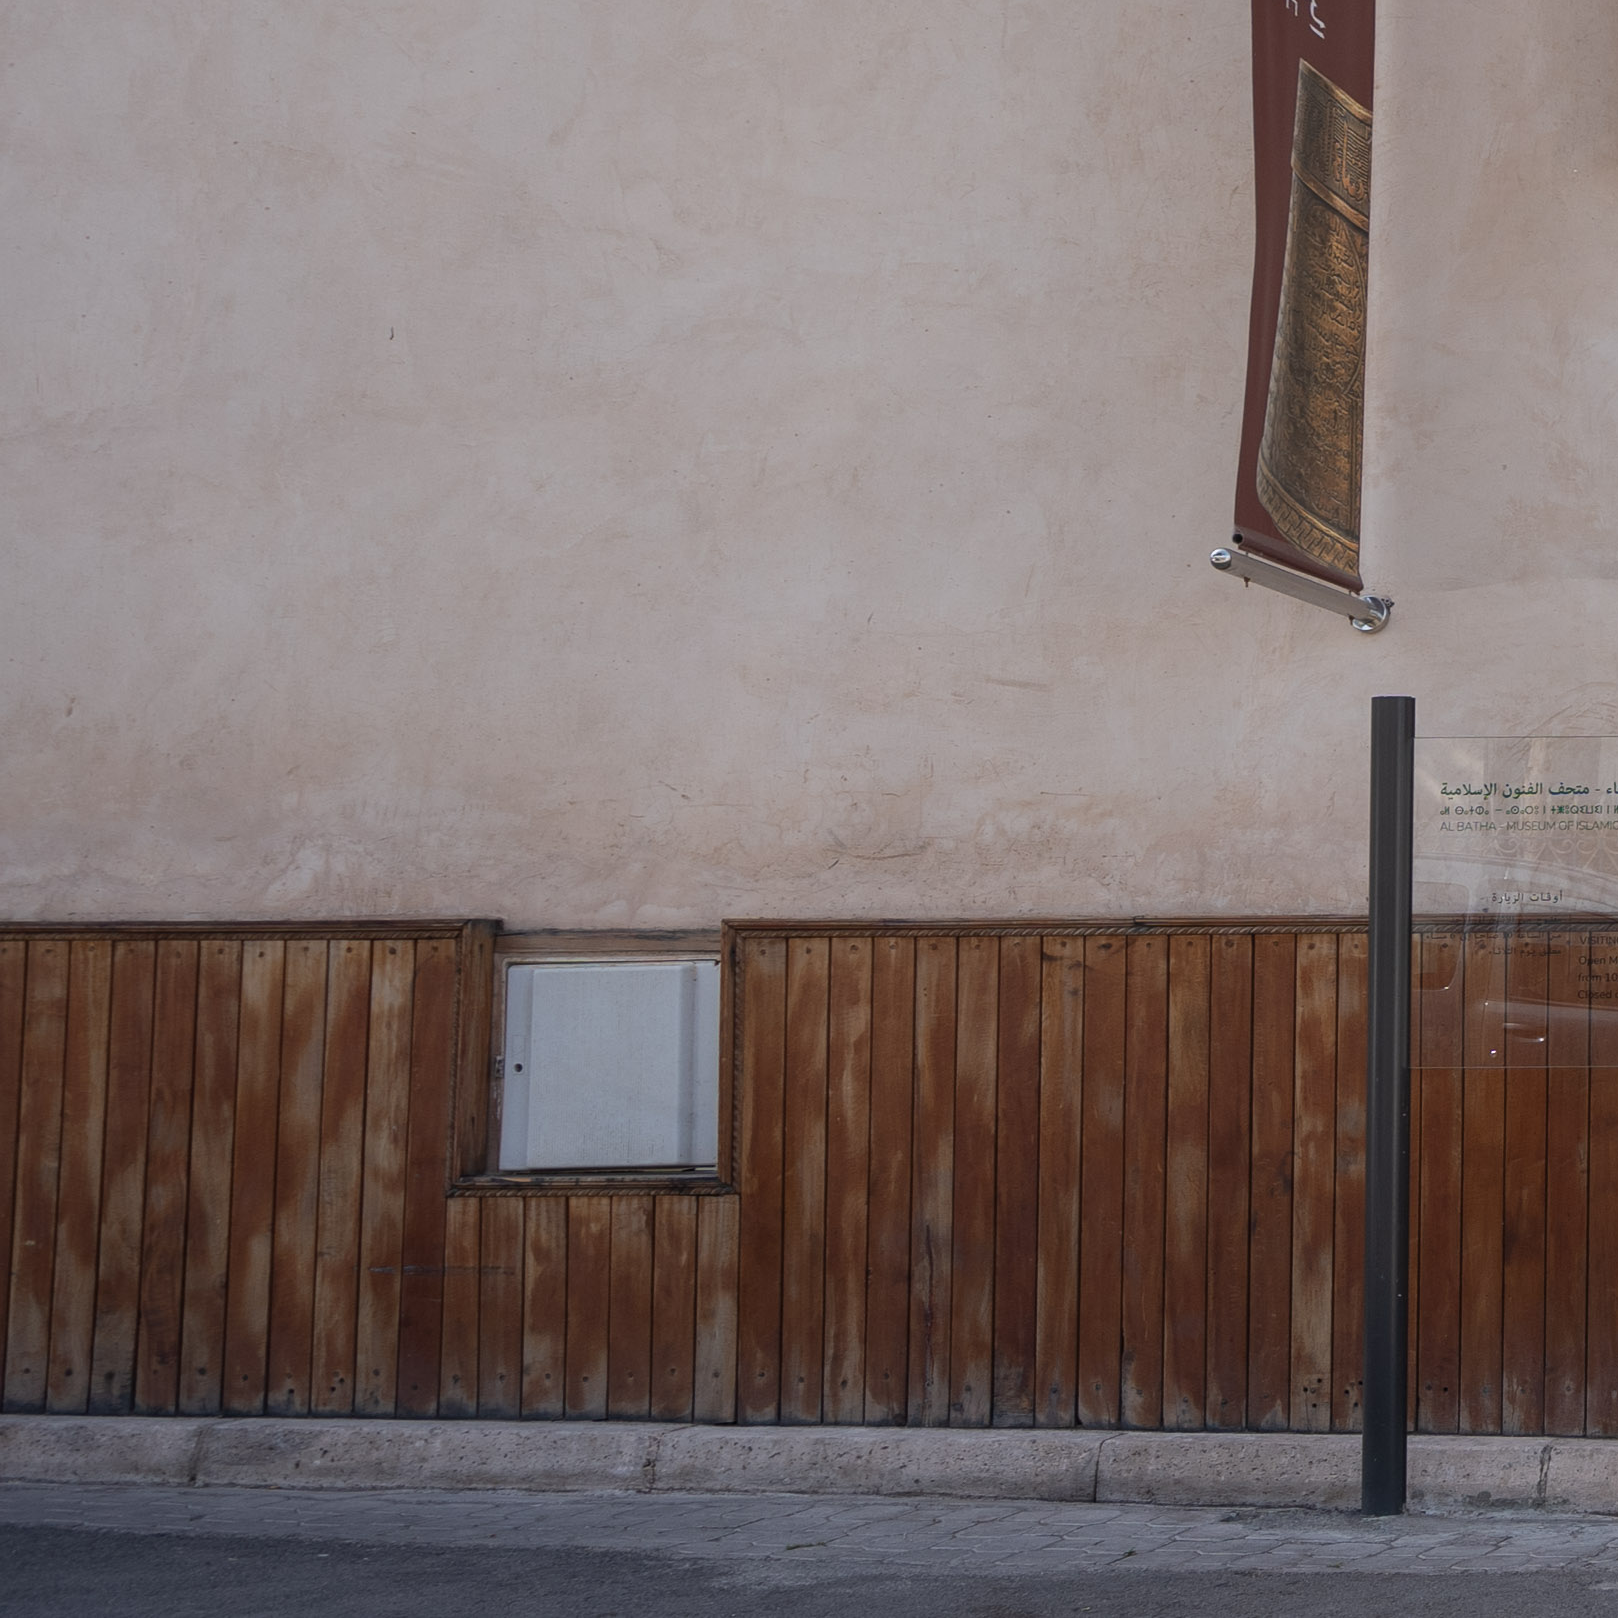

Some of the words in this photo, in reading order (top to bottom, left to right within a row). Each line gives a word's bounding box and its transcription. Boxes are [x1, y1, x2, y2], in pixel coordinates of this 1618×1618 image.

[1440, 782, 1497, 801] الإسلامية
[1502, 782, 1543, 798] الفنون
[1548, 782, 1589, 796] متحف
[1440, 821, 1454, 831] AL
[1457, 820, 1497, 831] BATHA
[1506, 820, 1556, 831] MUSEUM
[1559, 820, 1574, 831] OF
[1491, 892, 1524, 904] الزيارة
[1529, 890, 1563, 903] أوقات
[1578, 956, 1606, 966] Open
[1578, 973, 1602, 982] from
[1577, 990, 1612, 999] Closed
